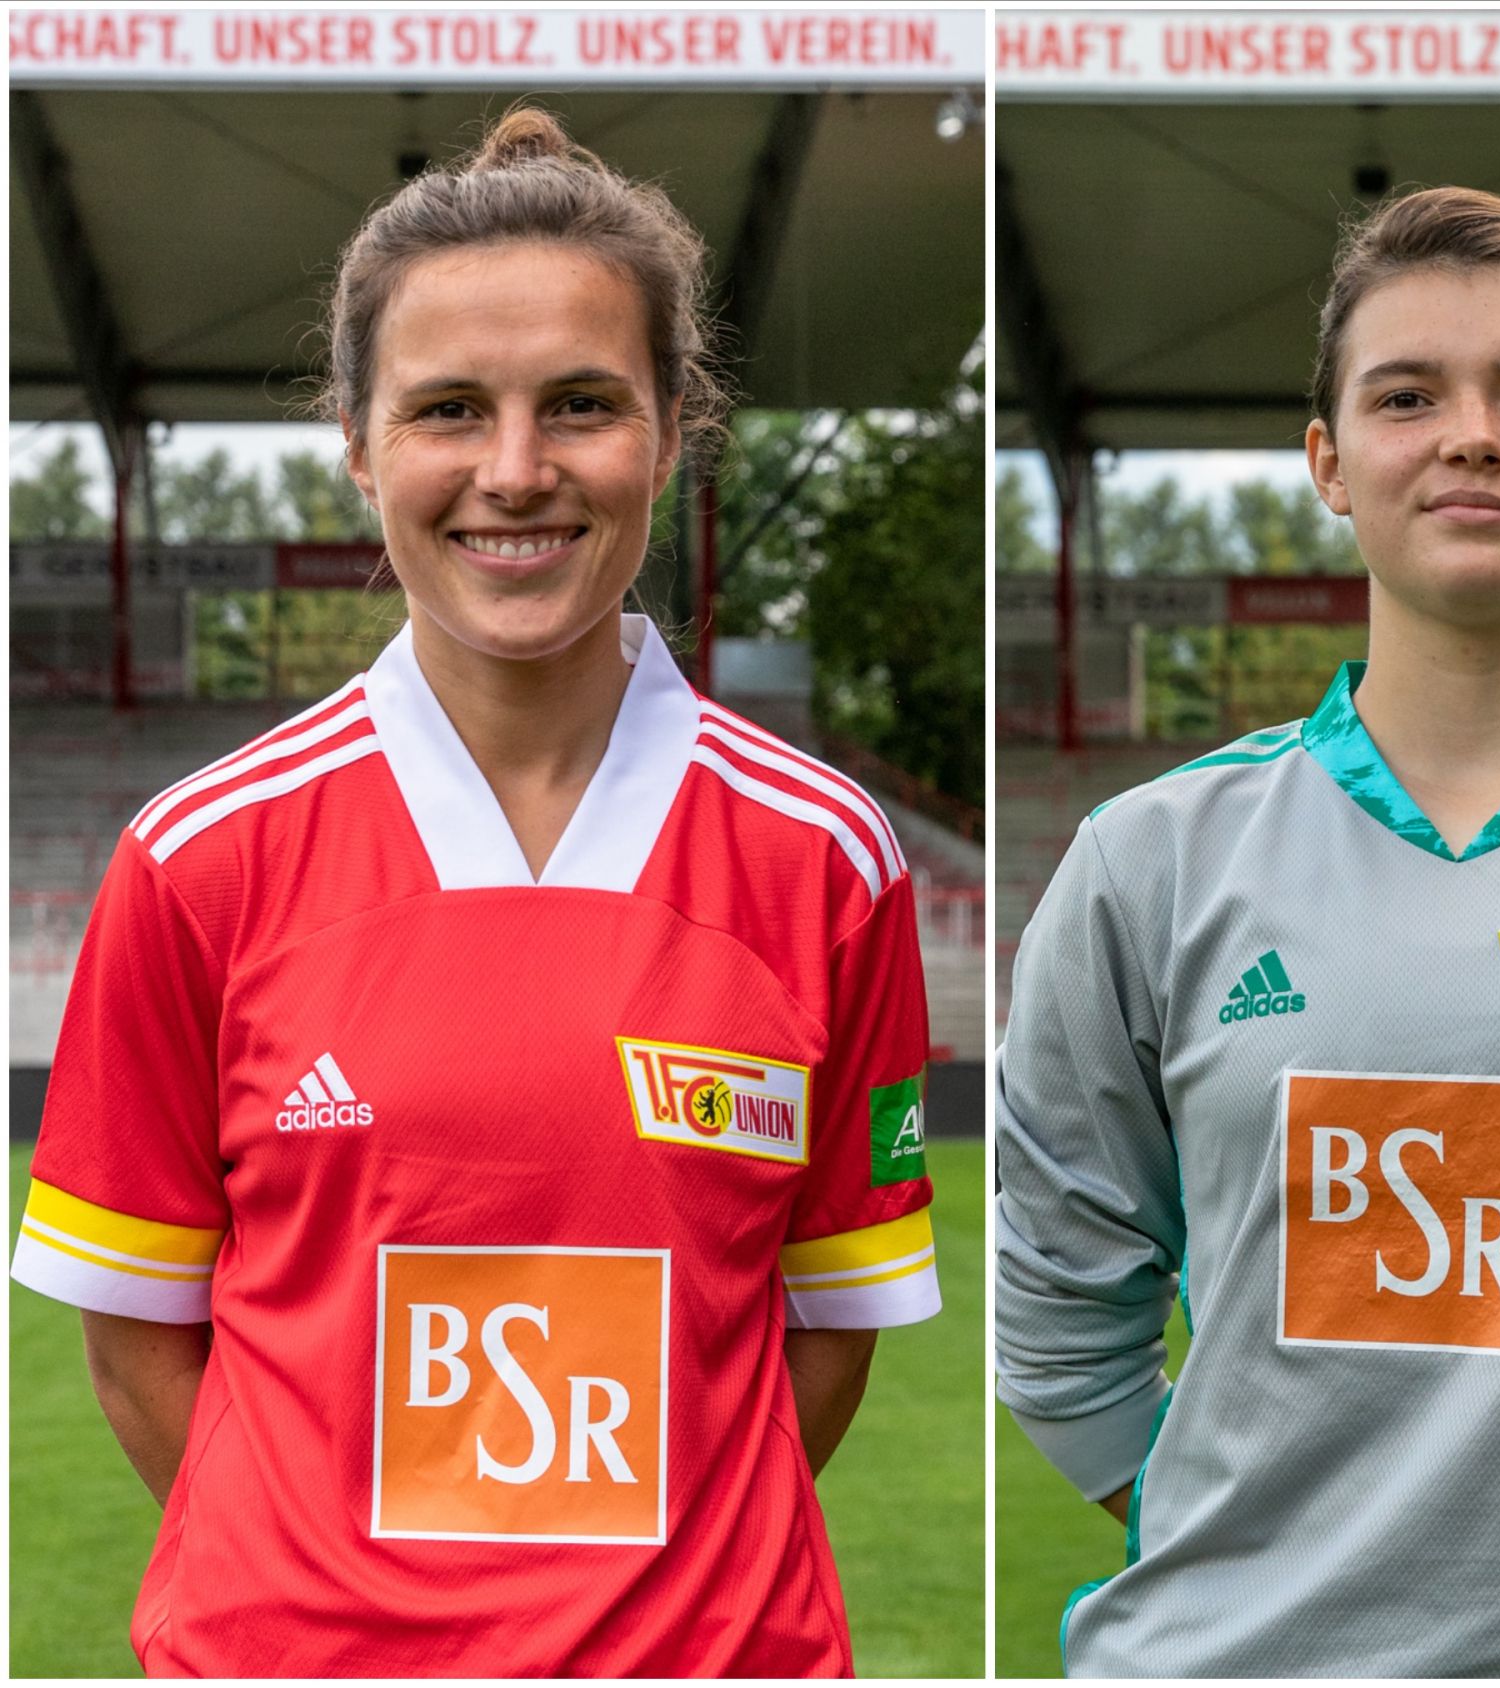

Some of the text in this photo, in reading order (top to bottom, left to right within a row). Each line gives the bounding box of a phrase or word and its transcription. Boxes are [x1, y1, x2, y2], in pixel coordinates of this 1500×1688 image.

[213, 15, 375, 65] UNSER
[391, 15, 553, 66] STOLZ.
[577, 16, 741, 66] UNSER
[761, 16, 952, 67] VEREIN.
[1163, 22, 1331, 75] UNSER
[1219, 992, 1306, 1025] adidas
[275, 1100, 374, 1132] adidas
[734, 1093, 795, 1141] UNION
[405, 1302, 639, 1485] BSR
